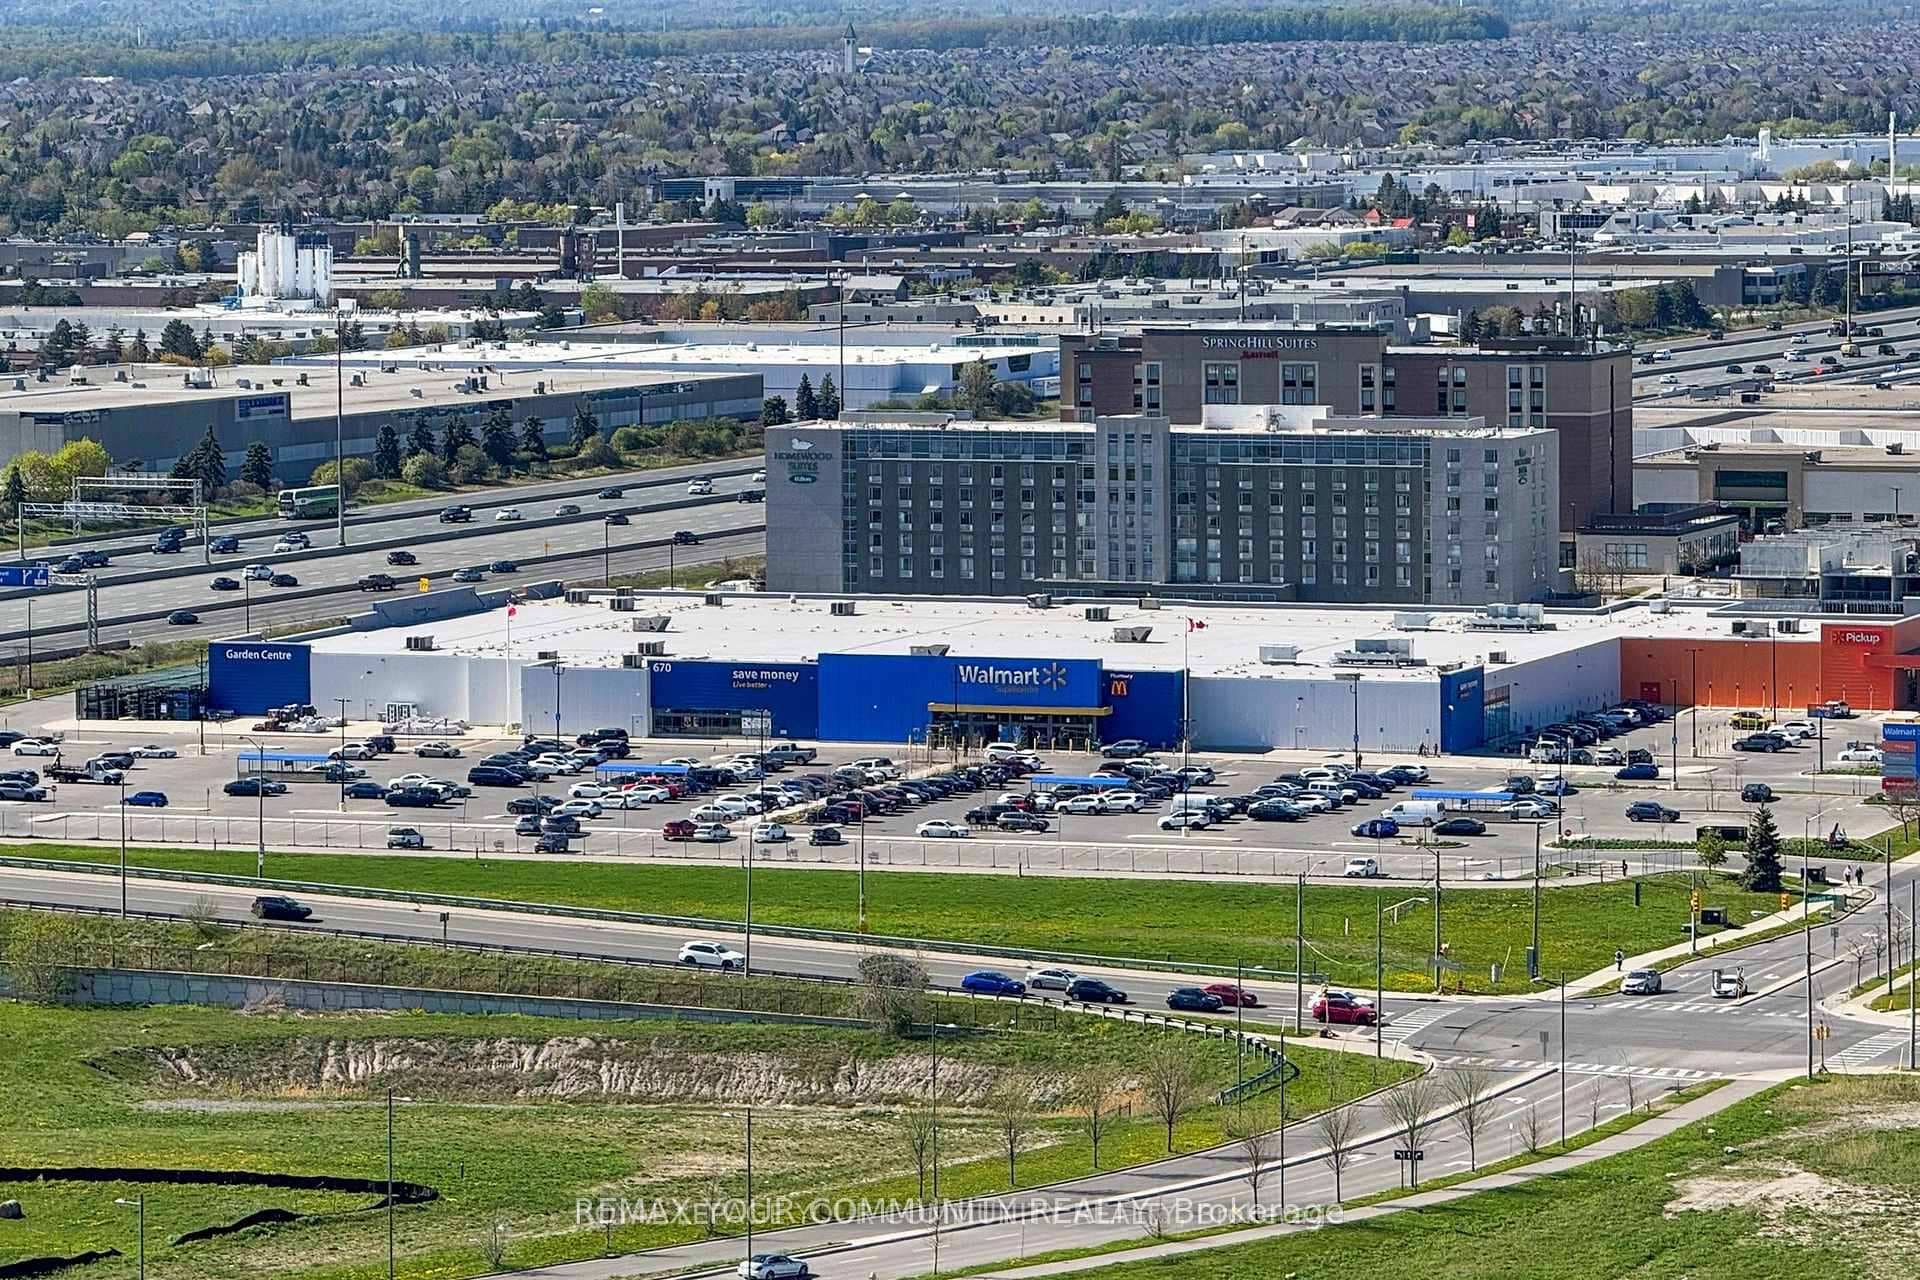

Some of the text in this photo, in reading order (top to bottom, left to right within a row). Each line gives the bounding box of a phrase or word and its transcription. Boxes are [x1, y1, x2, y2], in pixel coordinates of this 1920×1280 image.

[1276, 336, 1318, 349] SUITES
[1846, 631, 1880, 645] Pickup
[225, 649, 292, 660] Garden Centre
[652, 663, 672, 673] 670
[732, 670, 799, 683] save money
[959, 665, 1040, 686] Walmart
[1884, 727, 1916, 736] Walmart
